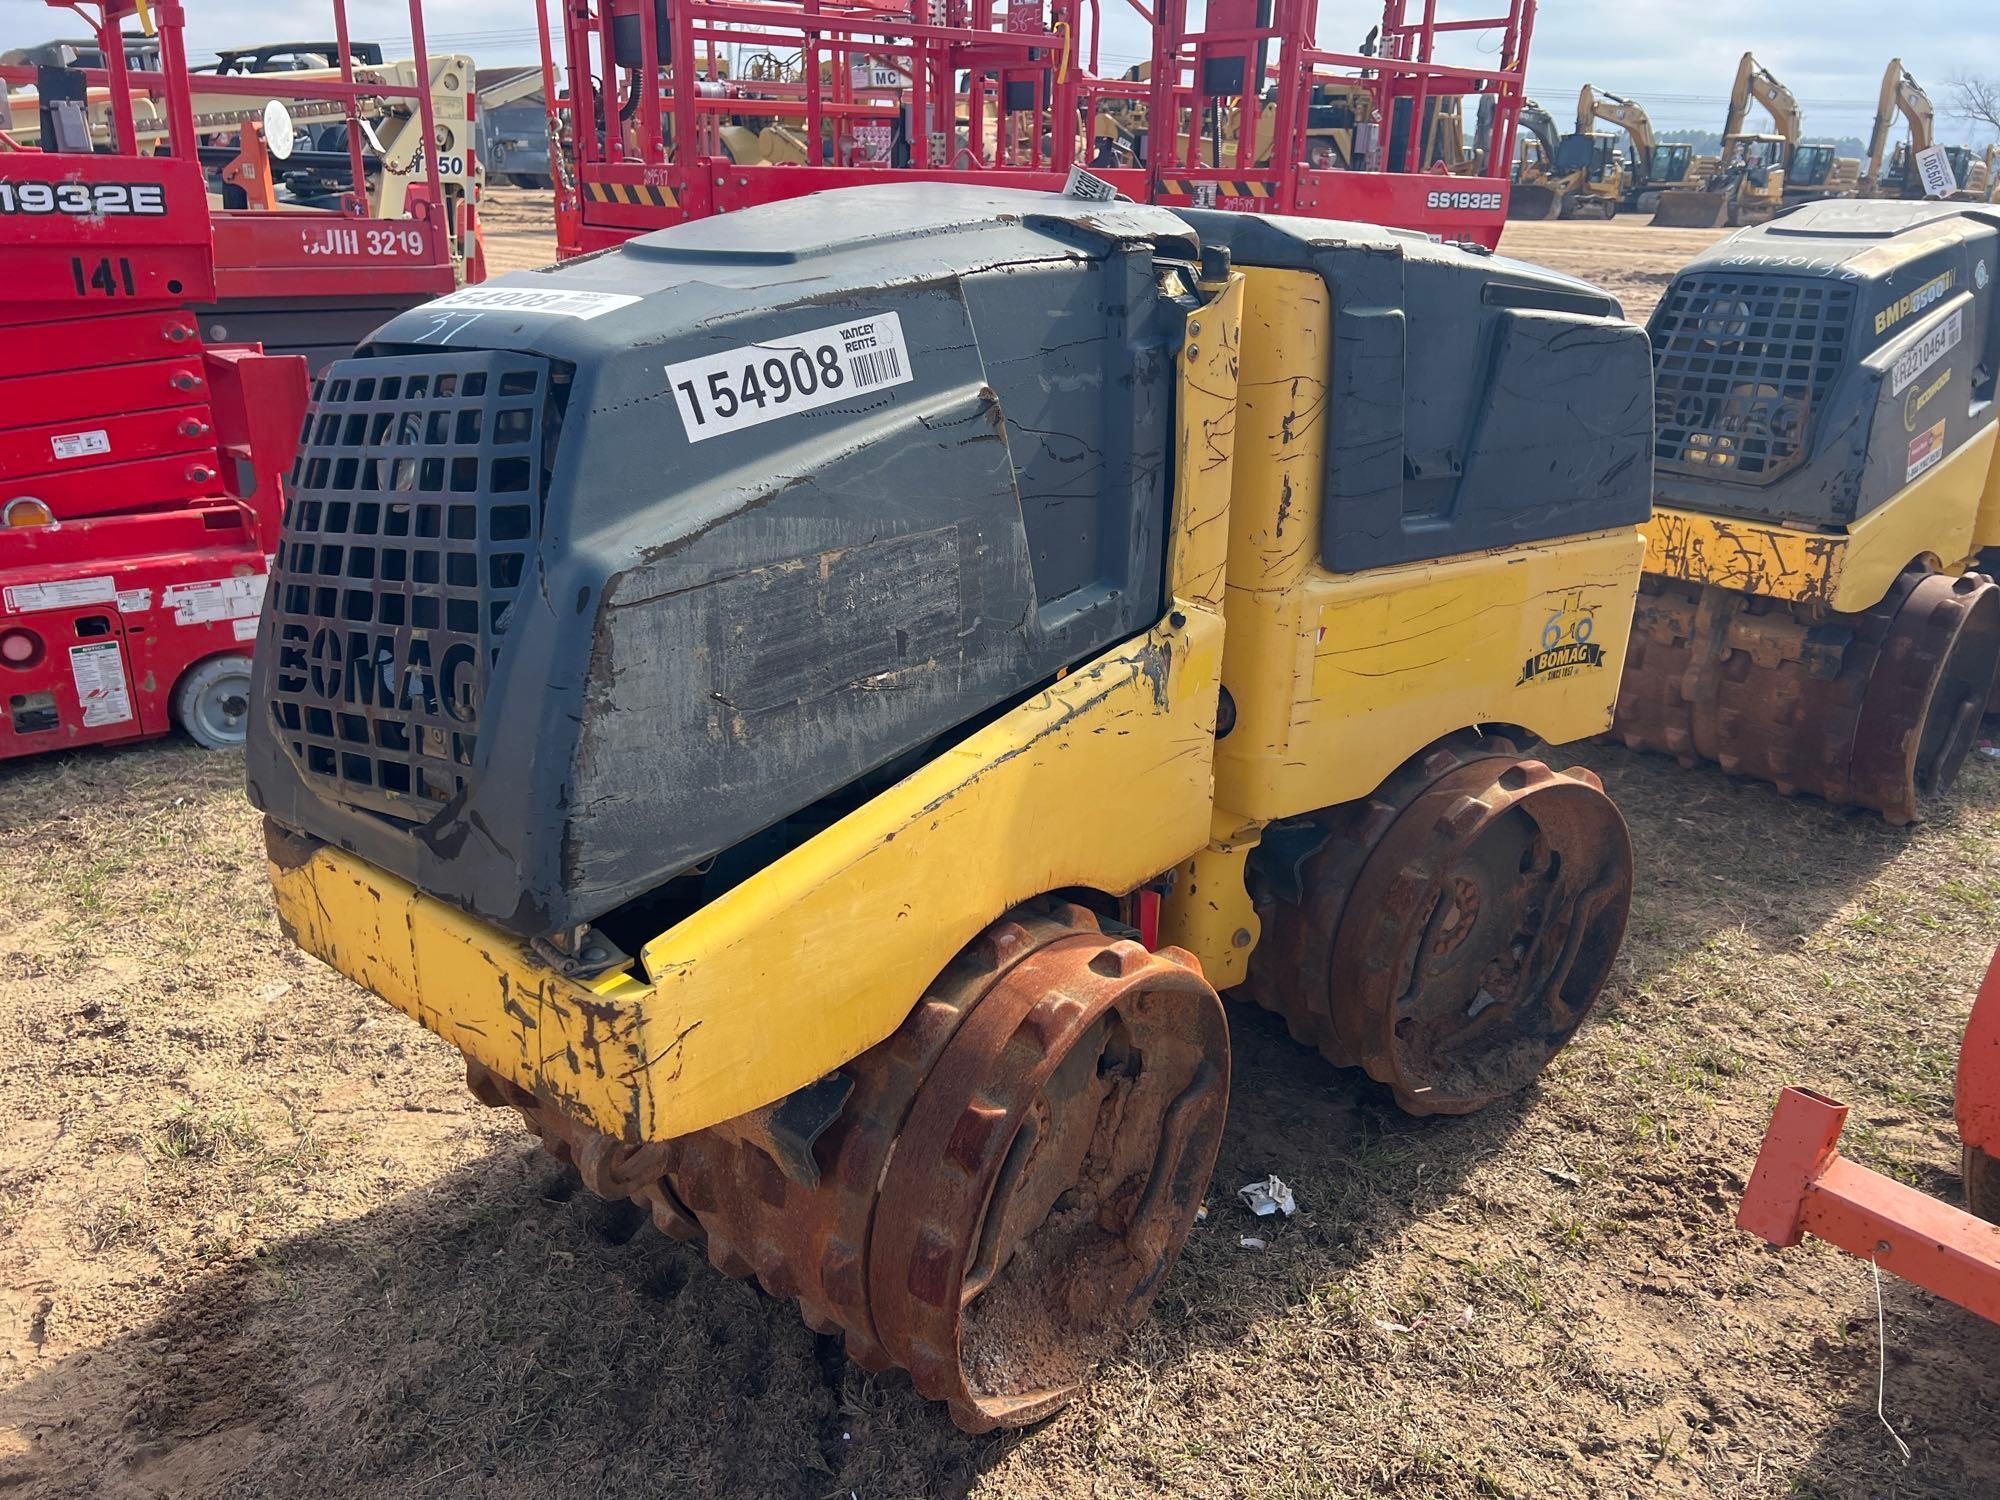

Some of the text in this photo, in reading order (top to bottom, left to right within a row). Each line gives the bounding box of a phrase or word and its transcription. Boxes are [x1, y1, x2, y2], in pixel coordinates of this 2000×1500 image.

[875, 72, 897, 85] MC
[1922, 153, 1945, 190] 209301
[1427, 191, 1502, 209] SS1932E
[366, 230, 424, 256] 3219
[1874, 280, 1946, 336] BMP 8500
[839, 322, 875, 341] YANCEY
[844, 336, 877, 353] RENTS
[677, 344, 845, 425] 154908
[1538, 645, 1588, 671] BOMAG
[278, 623, 477, 723] BOMAG
